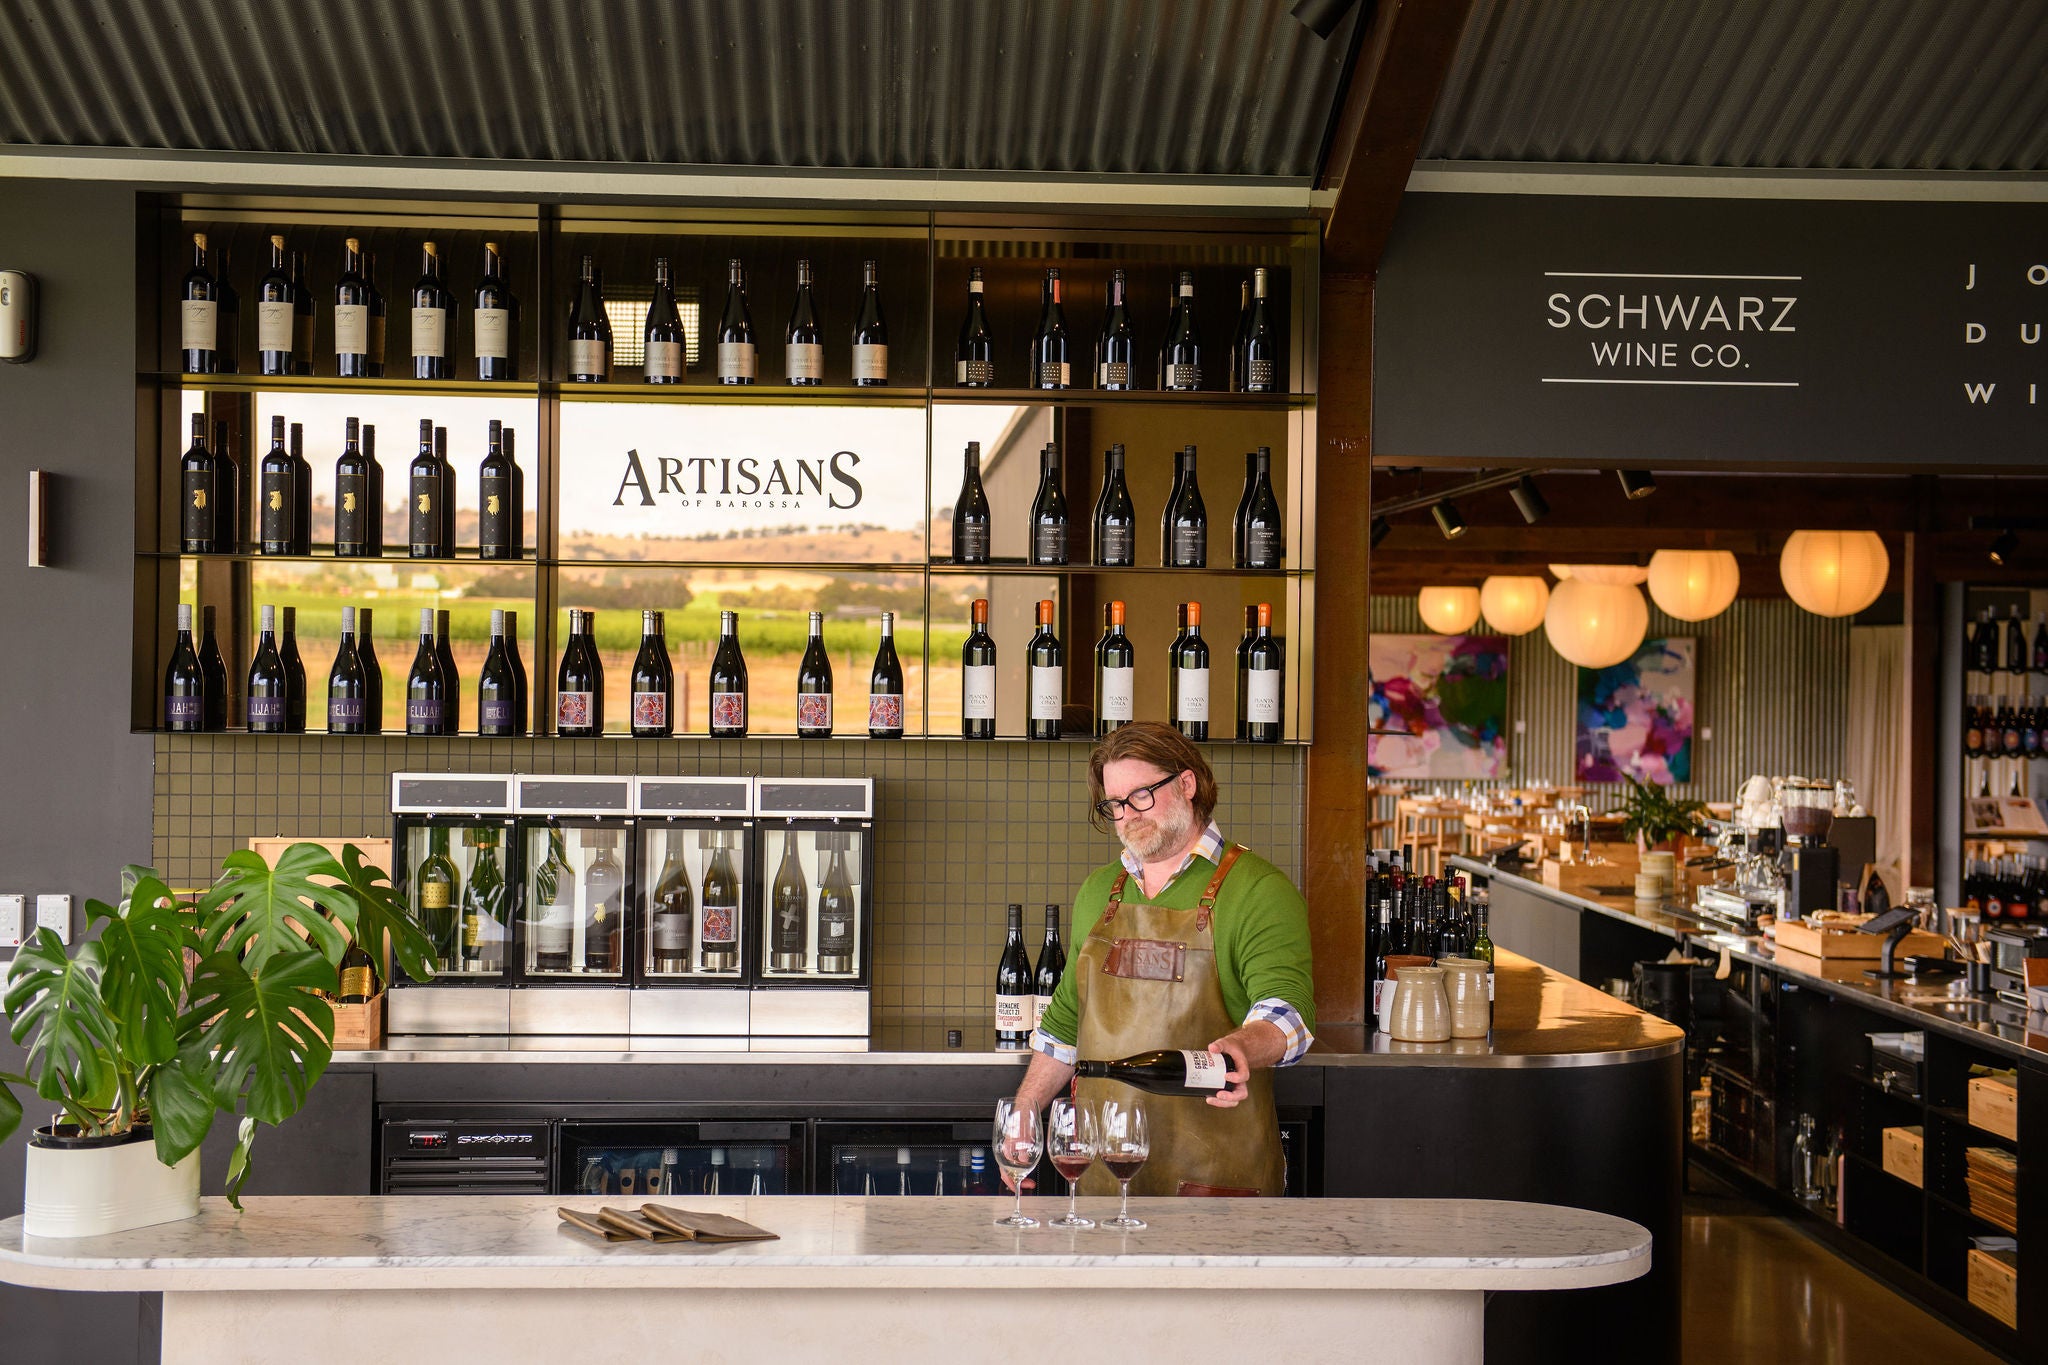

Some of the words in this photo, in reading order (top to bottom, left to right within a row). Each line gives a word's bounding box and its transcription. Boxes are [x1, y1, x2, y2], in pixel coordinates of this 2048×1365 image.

[1547, 293, 1797, 332] SCHWARZ
[1591, 341, 1678, 367] WINE
[1690, 343, 1750, 368] CO.
[612, 448, 863, 510] ARTISANS
[681, 500, 703, 508] OF
[715, 500, 801, 509] BAROSSA
